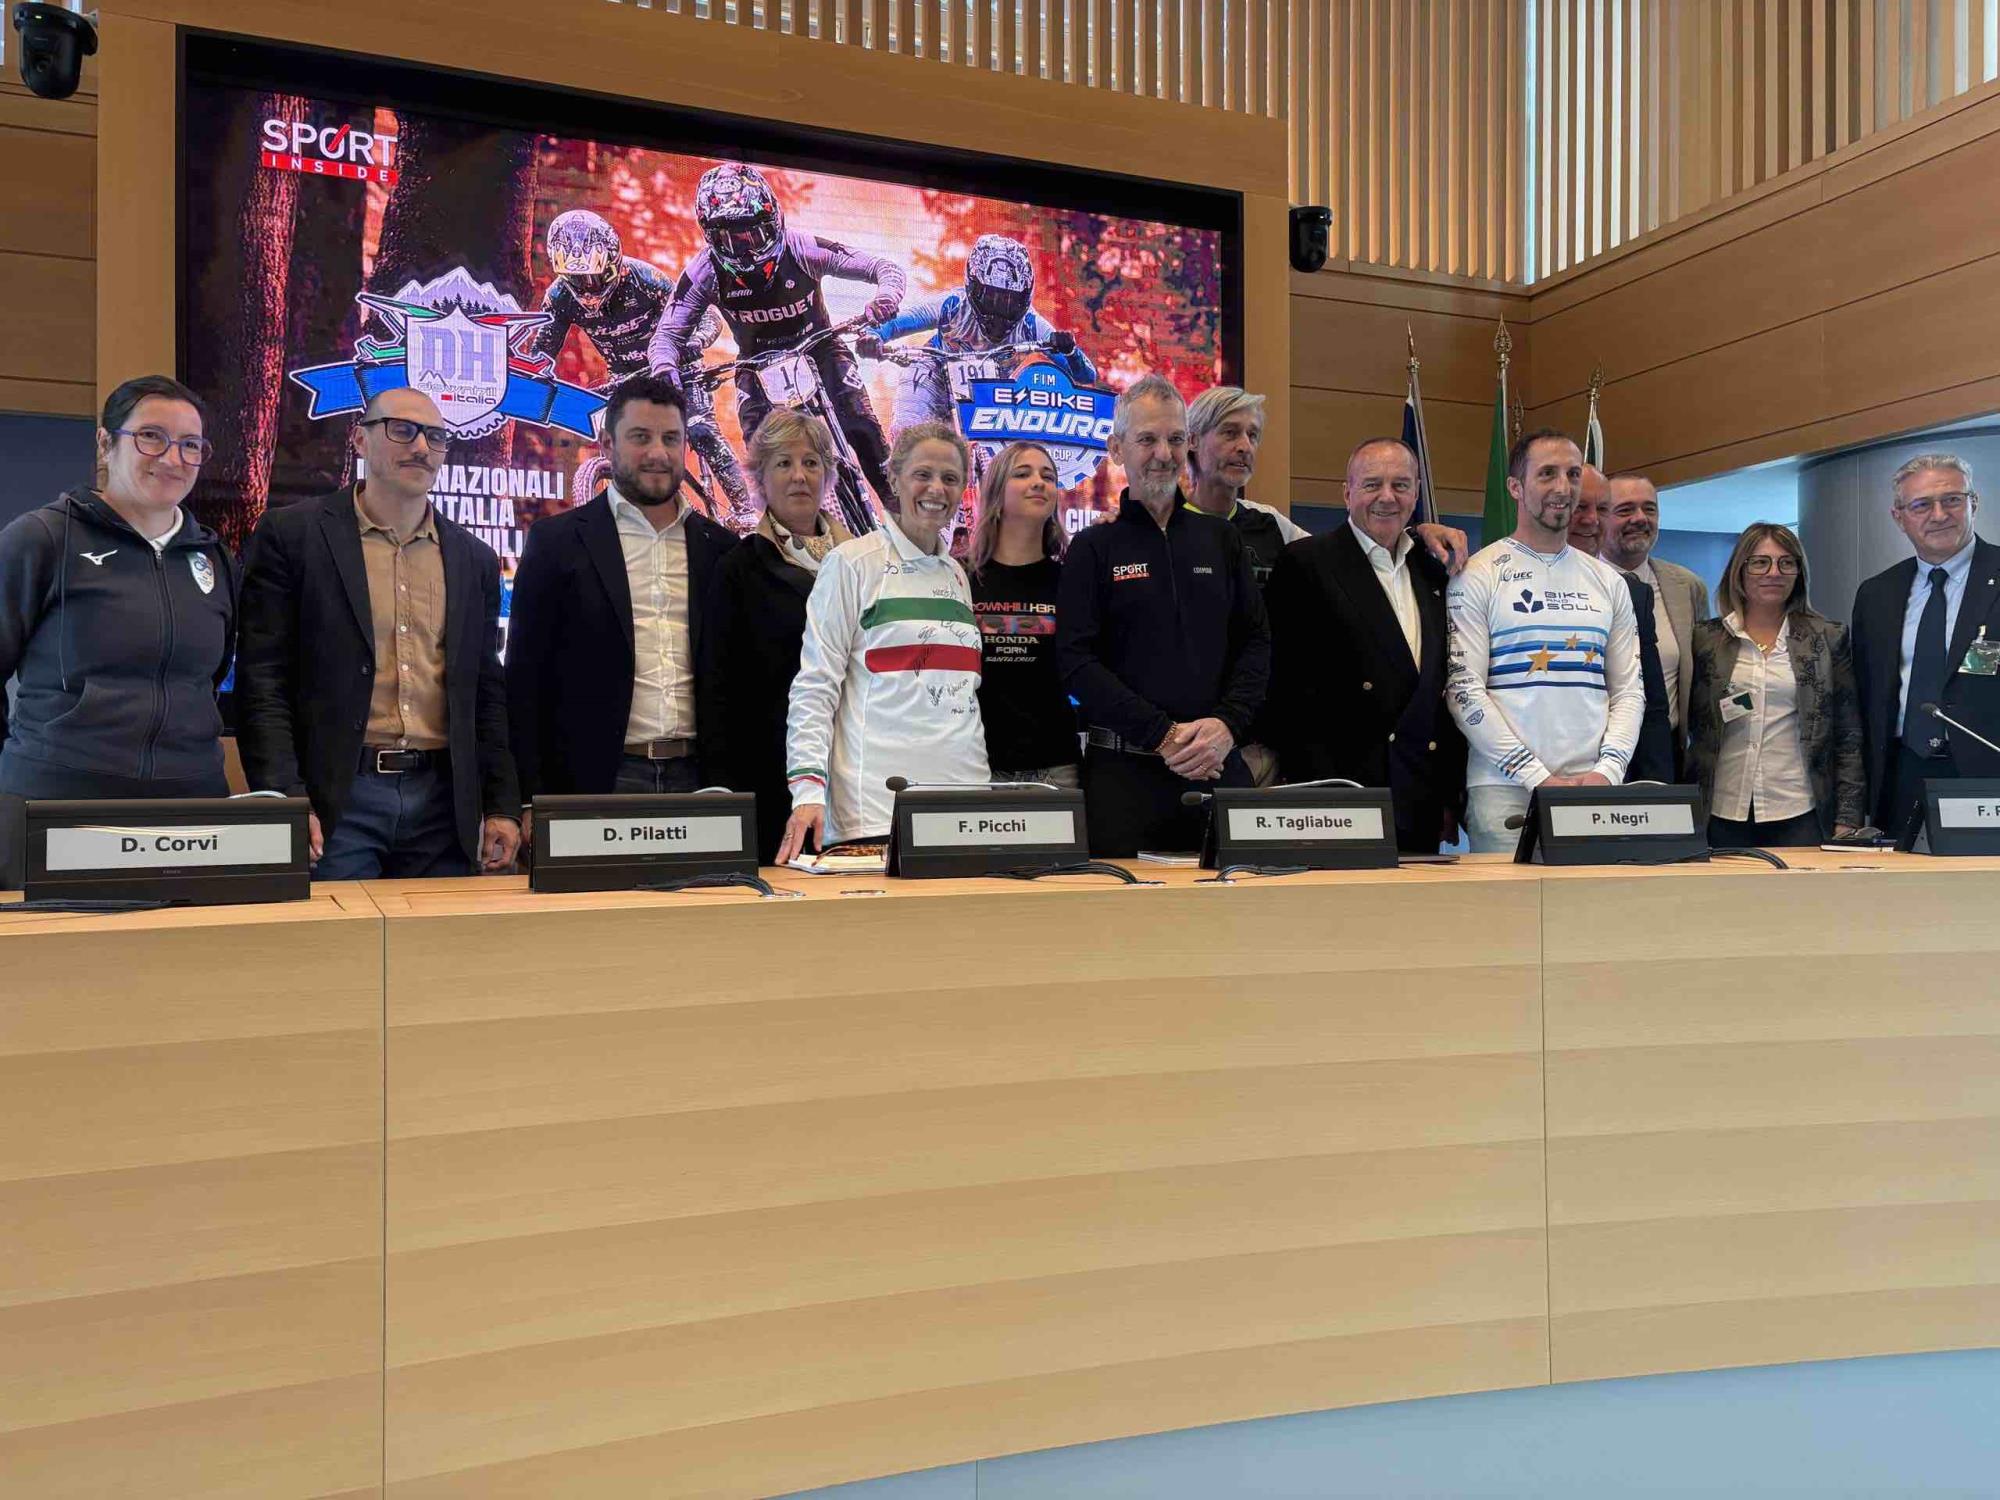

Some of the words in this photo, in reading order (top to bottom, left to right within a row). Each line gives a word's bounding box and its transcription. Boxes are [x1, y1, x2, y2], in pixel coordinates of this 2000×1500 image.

[262, 119, 398, 166] SPORT
[272, 154, 389, 182] INSIDE
[739, 299, 809, 324] ROGUE
[418, 326, 497, 383] DH
[779, 366, 794, 390] 1
[1033, 373, 1056, 387] FIM
[970, 407, 1115, 441] ENDURO
[1053, 448, 1073, 462] CUP
[1112, 563, 1148, 576] SPORT
[1513, 571, 1533, 579] UEC
[1544, 591, 1589, 600] BIKE
[1547, 603, 1602, 613] SOUL
[984, 635, 1040, 644] HONDA
[1977, 805, 1991, 817] F.
[958, 820, 973, 834] F.
[978, 819, 1027, 834] Picchi
[1255, 816, 1272, 829] R.
[1276, 815, 1353, 831] Tagliabue
[1591, 813, 1606, 825] P.
[1610, 812, 1649, 826] Negri
[602, 827, 624, 842] D.
[630, 825, 687, 842] Pilatti
[120, 837, 146, 853] D.
[155, 835, 218, 853] Corvi
